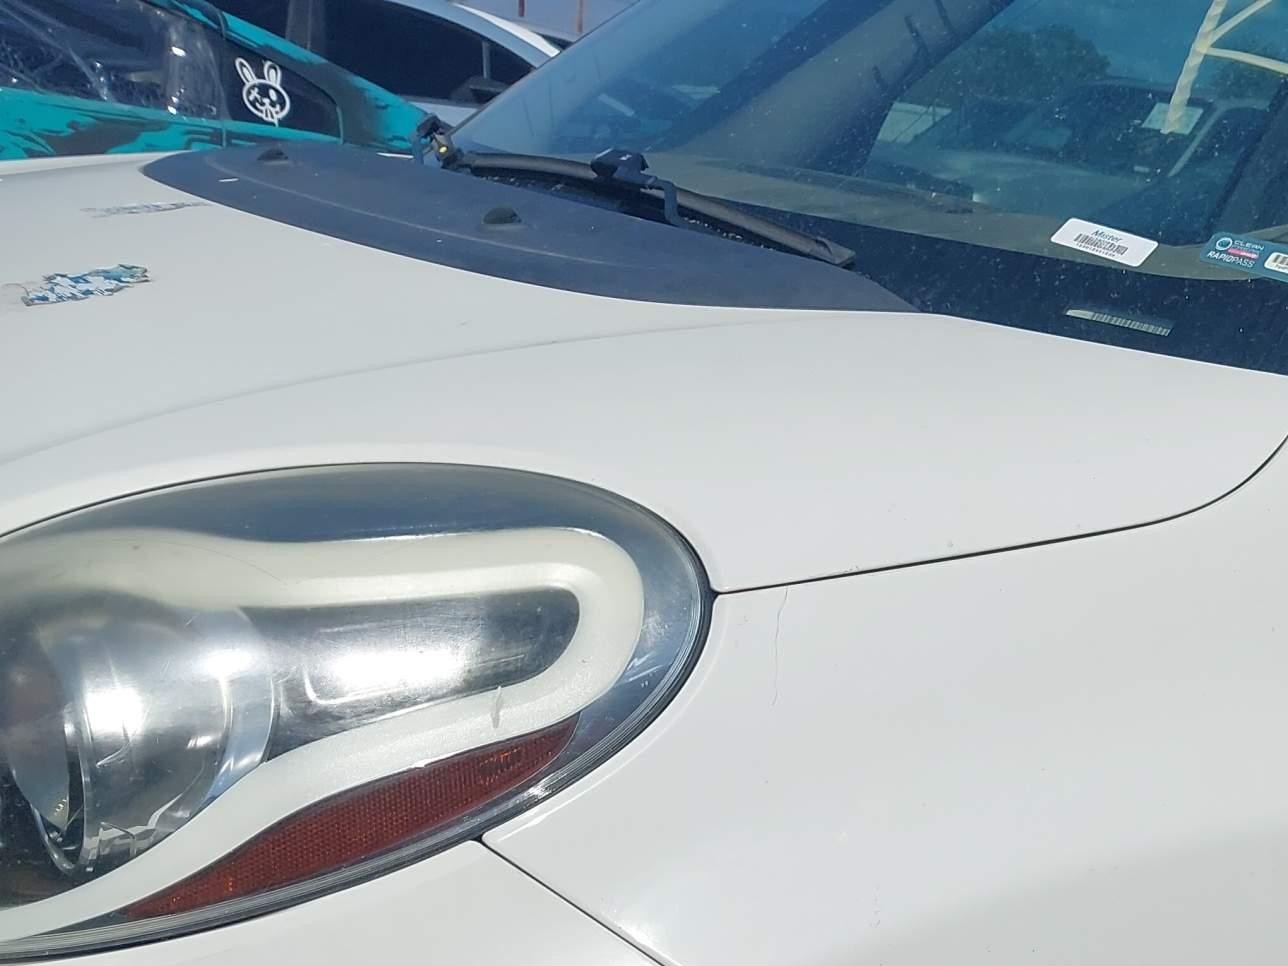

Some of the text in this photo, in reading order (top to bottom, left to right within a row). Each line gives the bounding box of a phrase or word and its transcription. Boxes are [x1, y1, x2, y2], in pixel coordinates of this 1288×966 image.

[1091, 224, 1122, 243] Mister
[1234, 240, 1265, 251] CLEAN
[1207, 250, 1256, 268] RAPIDPASS
